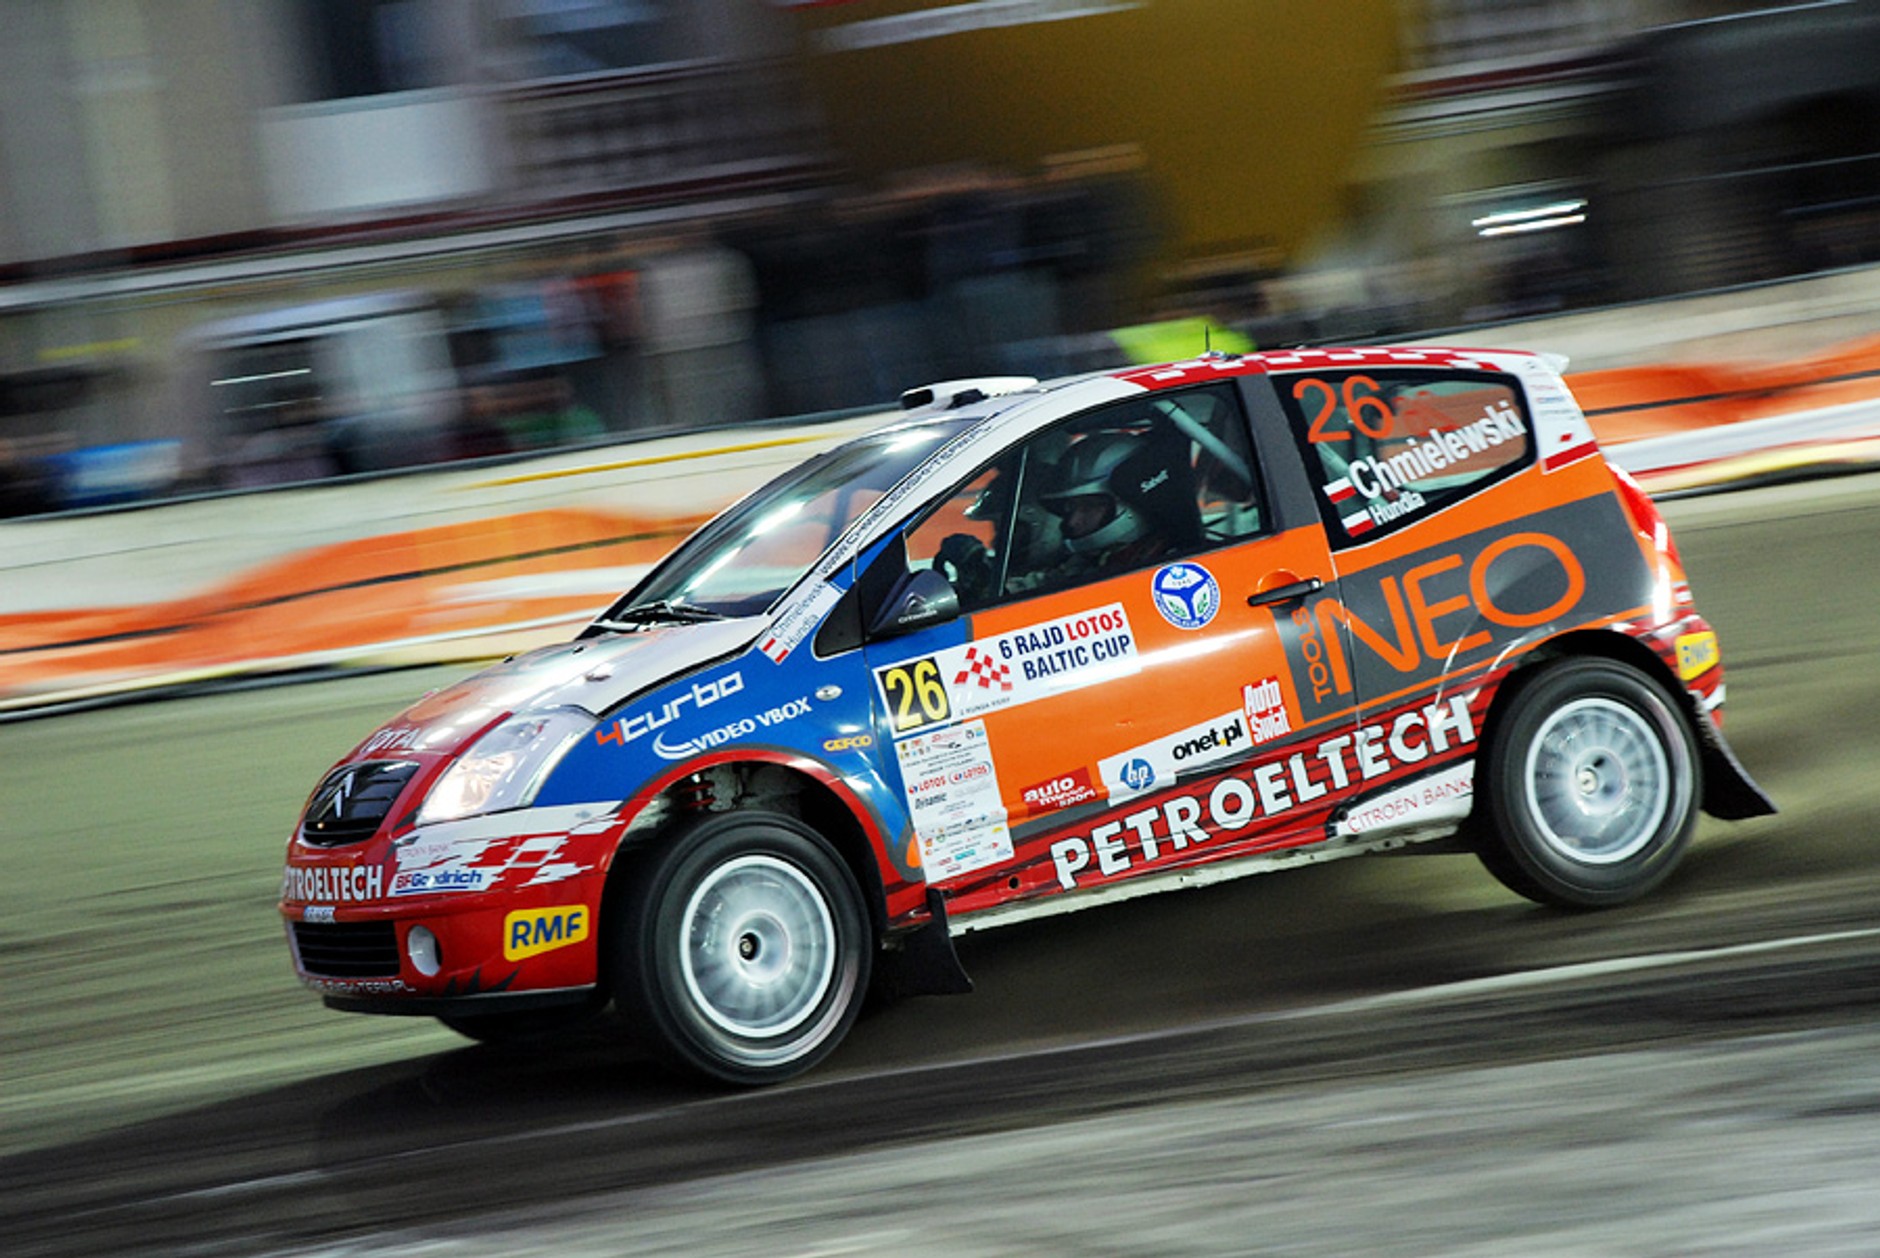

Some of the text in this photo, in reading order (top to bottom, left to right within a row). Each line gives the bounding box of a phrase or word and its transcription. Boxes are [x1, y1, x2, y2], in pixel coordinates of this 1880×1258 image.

[1292, 374, 1394, 443] 26
[1349, 400, 1527, 499] Chmielewski
[998, 609, 1124, 660] 6 RAJD LOTOS
[1313, 531, 1586, 696] NEO
[1022, 634, 1131, 681] BALTIC CUP
[1291, 606, 1332, 704] TOOLS
[595, 671, 745, 747] 4turbo
[886, 660, 948, 731] 26
[1245, 678, 1282, 717] Auto
[691, 696, 813, 751] VIDEO VBOX
[823, 734, 873, 752] GEFCO
[1172, 718, 1244, 761] onet.pl
[919, 775, 947, 792] LOTOS
[1024, 777, 1075, 802] auto
[1050, 694, 1476, 892] PETROELTECH
[1124, 758, 1152, 790] hp
[395, 869, 482, 889] BFGodrich
[511, 911, 582, 949] RMF
